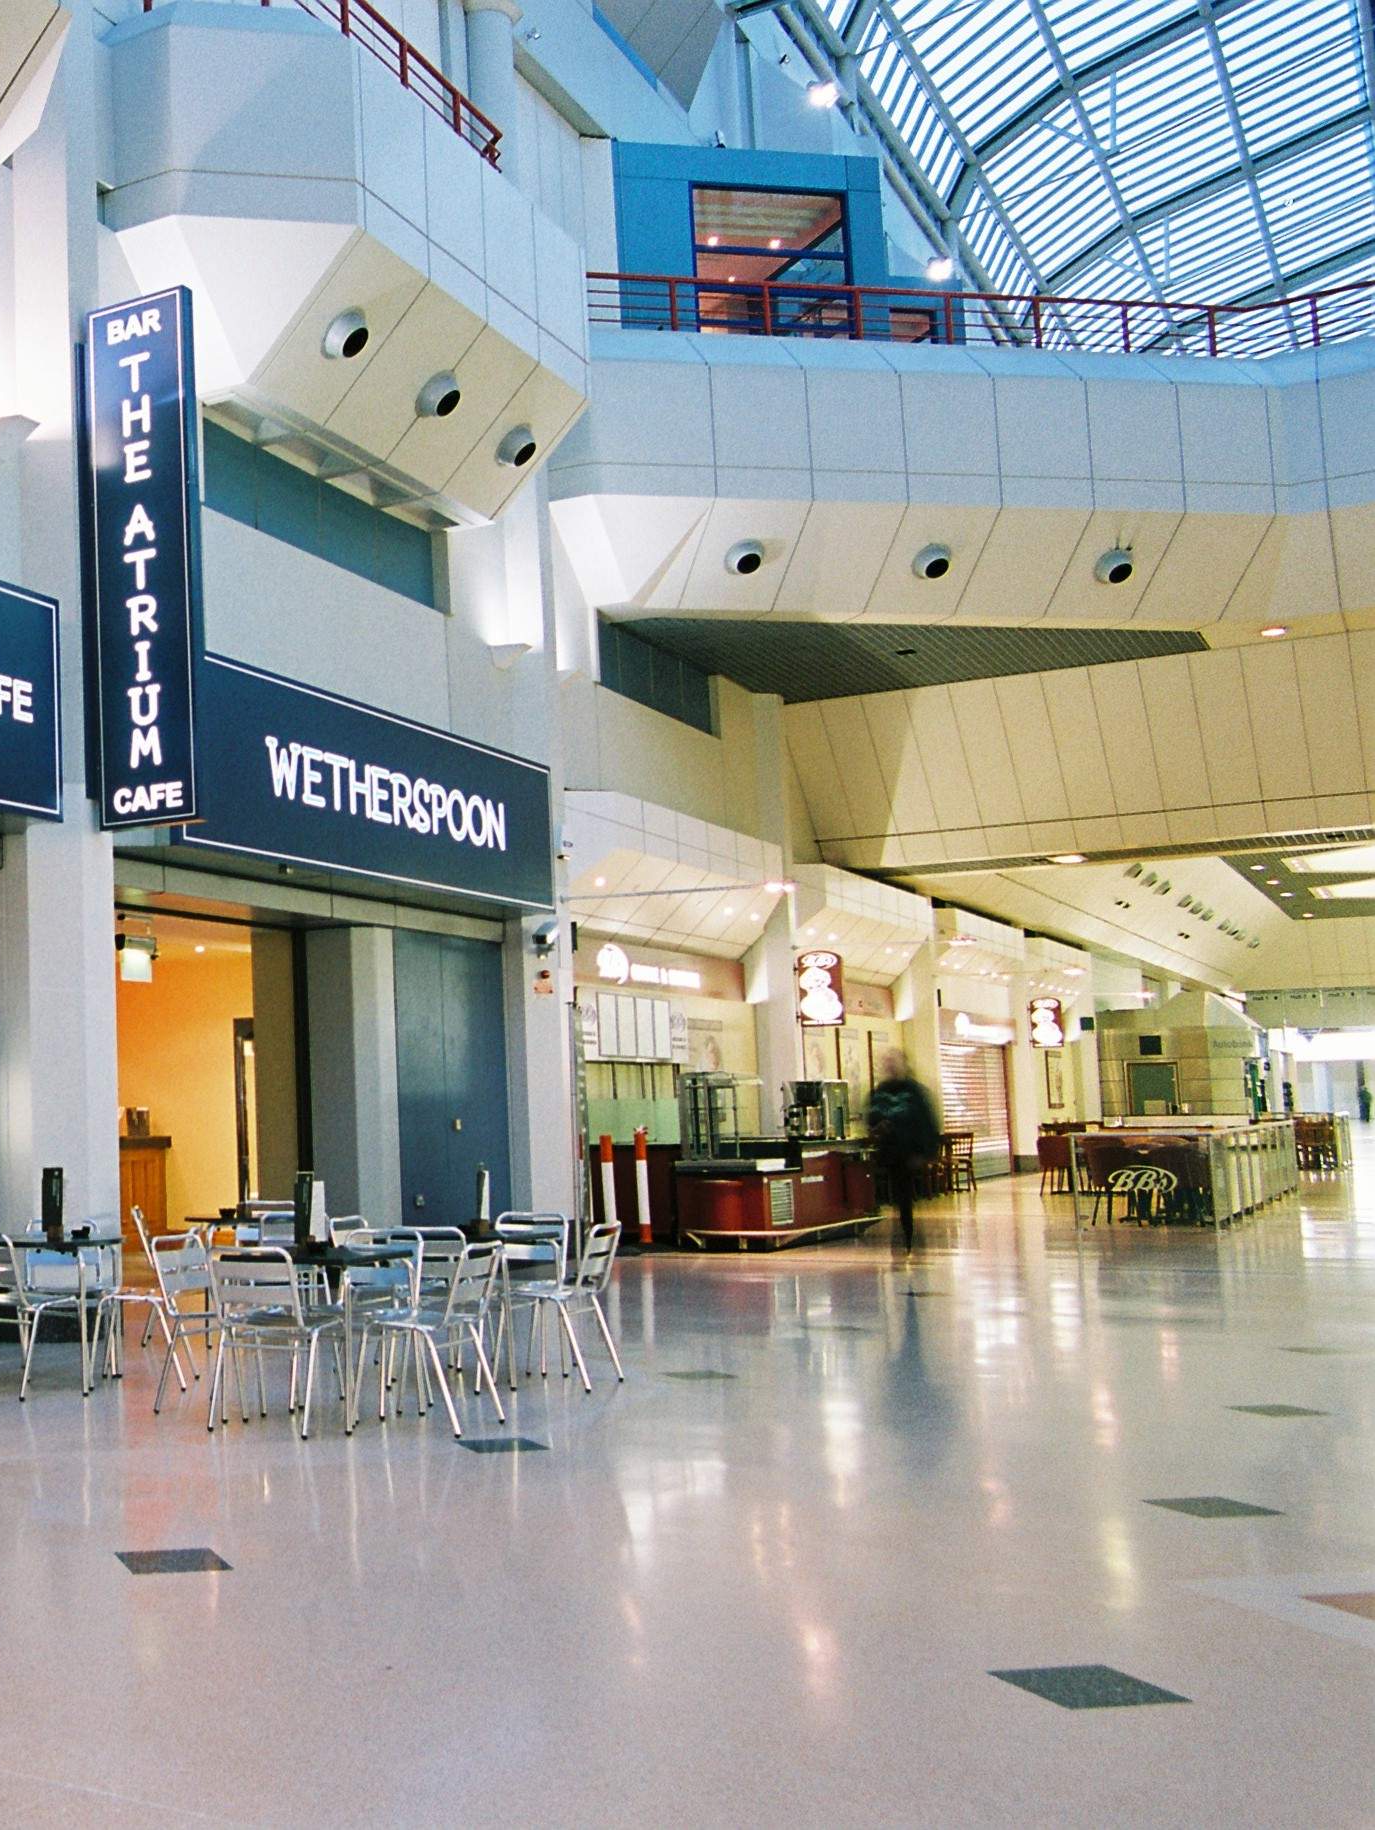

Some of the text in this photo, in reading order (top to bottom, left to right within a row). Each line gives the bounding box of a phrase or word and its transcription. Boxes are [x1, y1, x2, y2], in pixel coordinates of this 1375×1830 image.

[106, 307, 162, 346] BAR
[118, 350, 162, 770] THE ATRIUM
[112, 780, 185, 816] CAFE
[264, 735, 508, 852] WETHERSPOON
